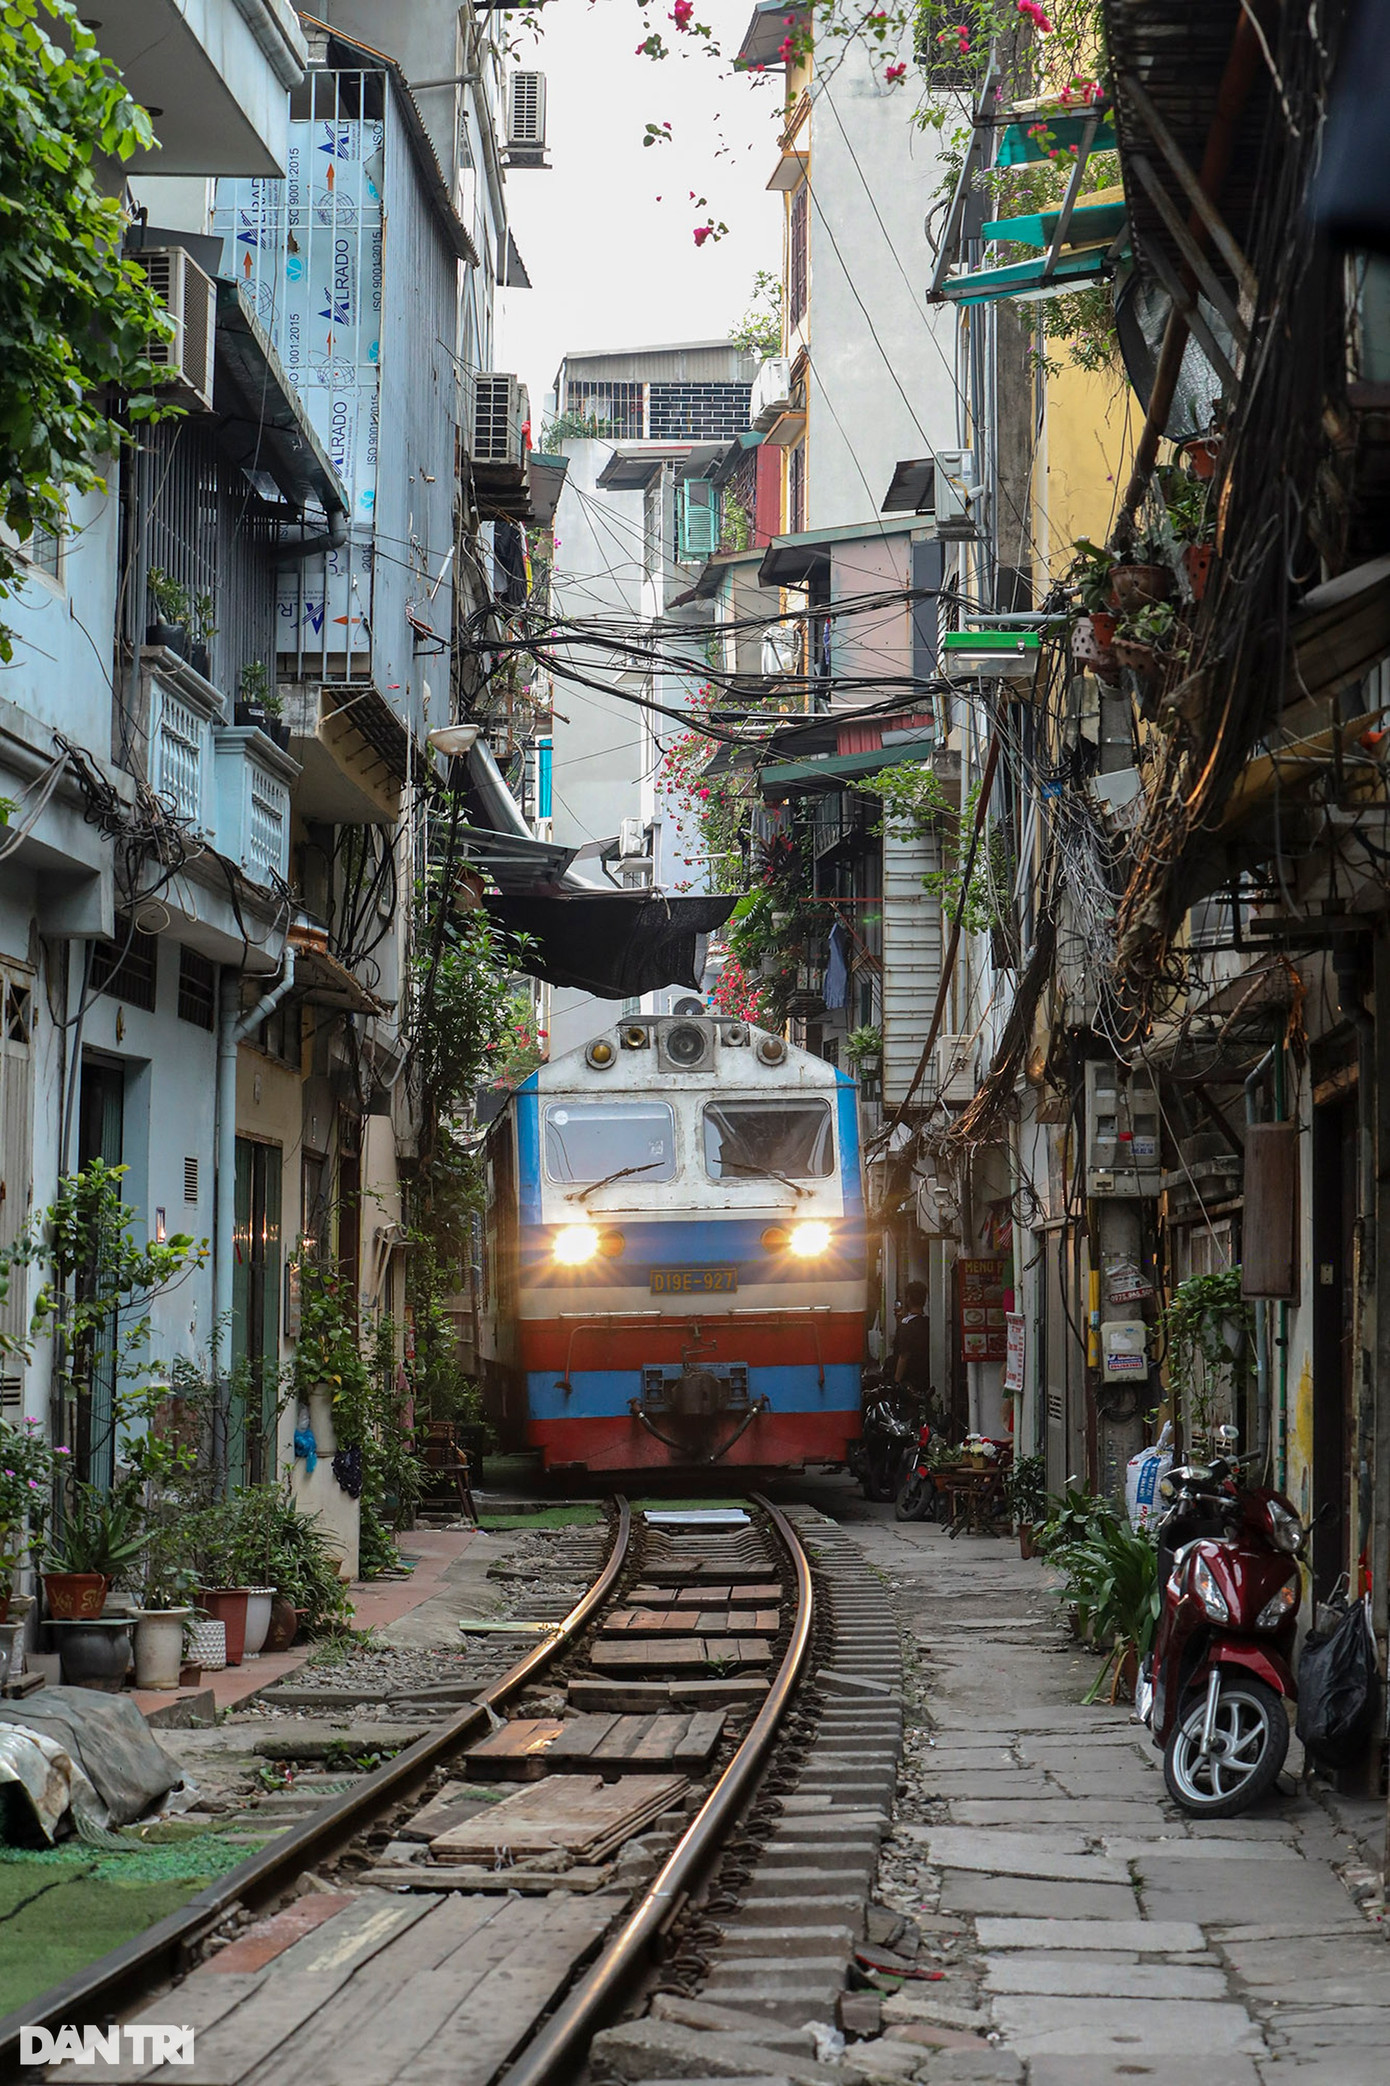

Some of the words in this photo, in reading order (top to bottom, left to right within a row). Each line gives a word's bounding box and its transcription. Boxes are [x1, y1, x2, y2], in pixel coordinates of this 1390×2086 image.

[289, 147, 299, 205] 9001:2015
[317, 239, 349, 327] ALRADO
[373, 291, 381, 311] ISO
[290, 313, 299, 369] 001:2015
[367, 445, 377, 466] ISO
[655, 1272, 733, 1291] D19E-927
